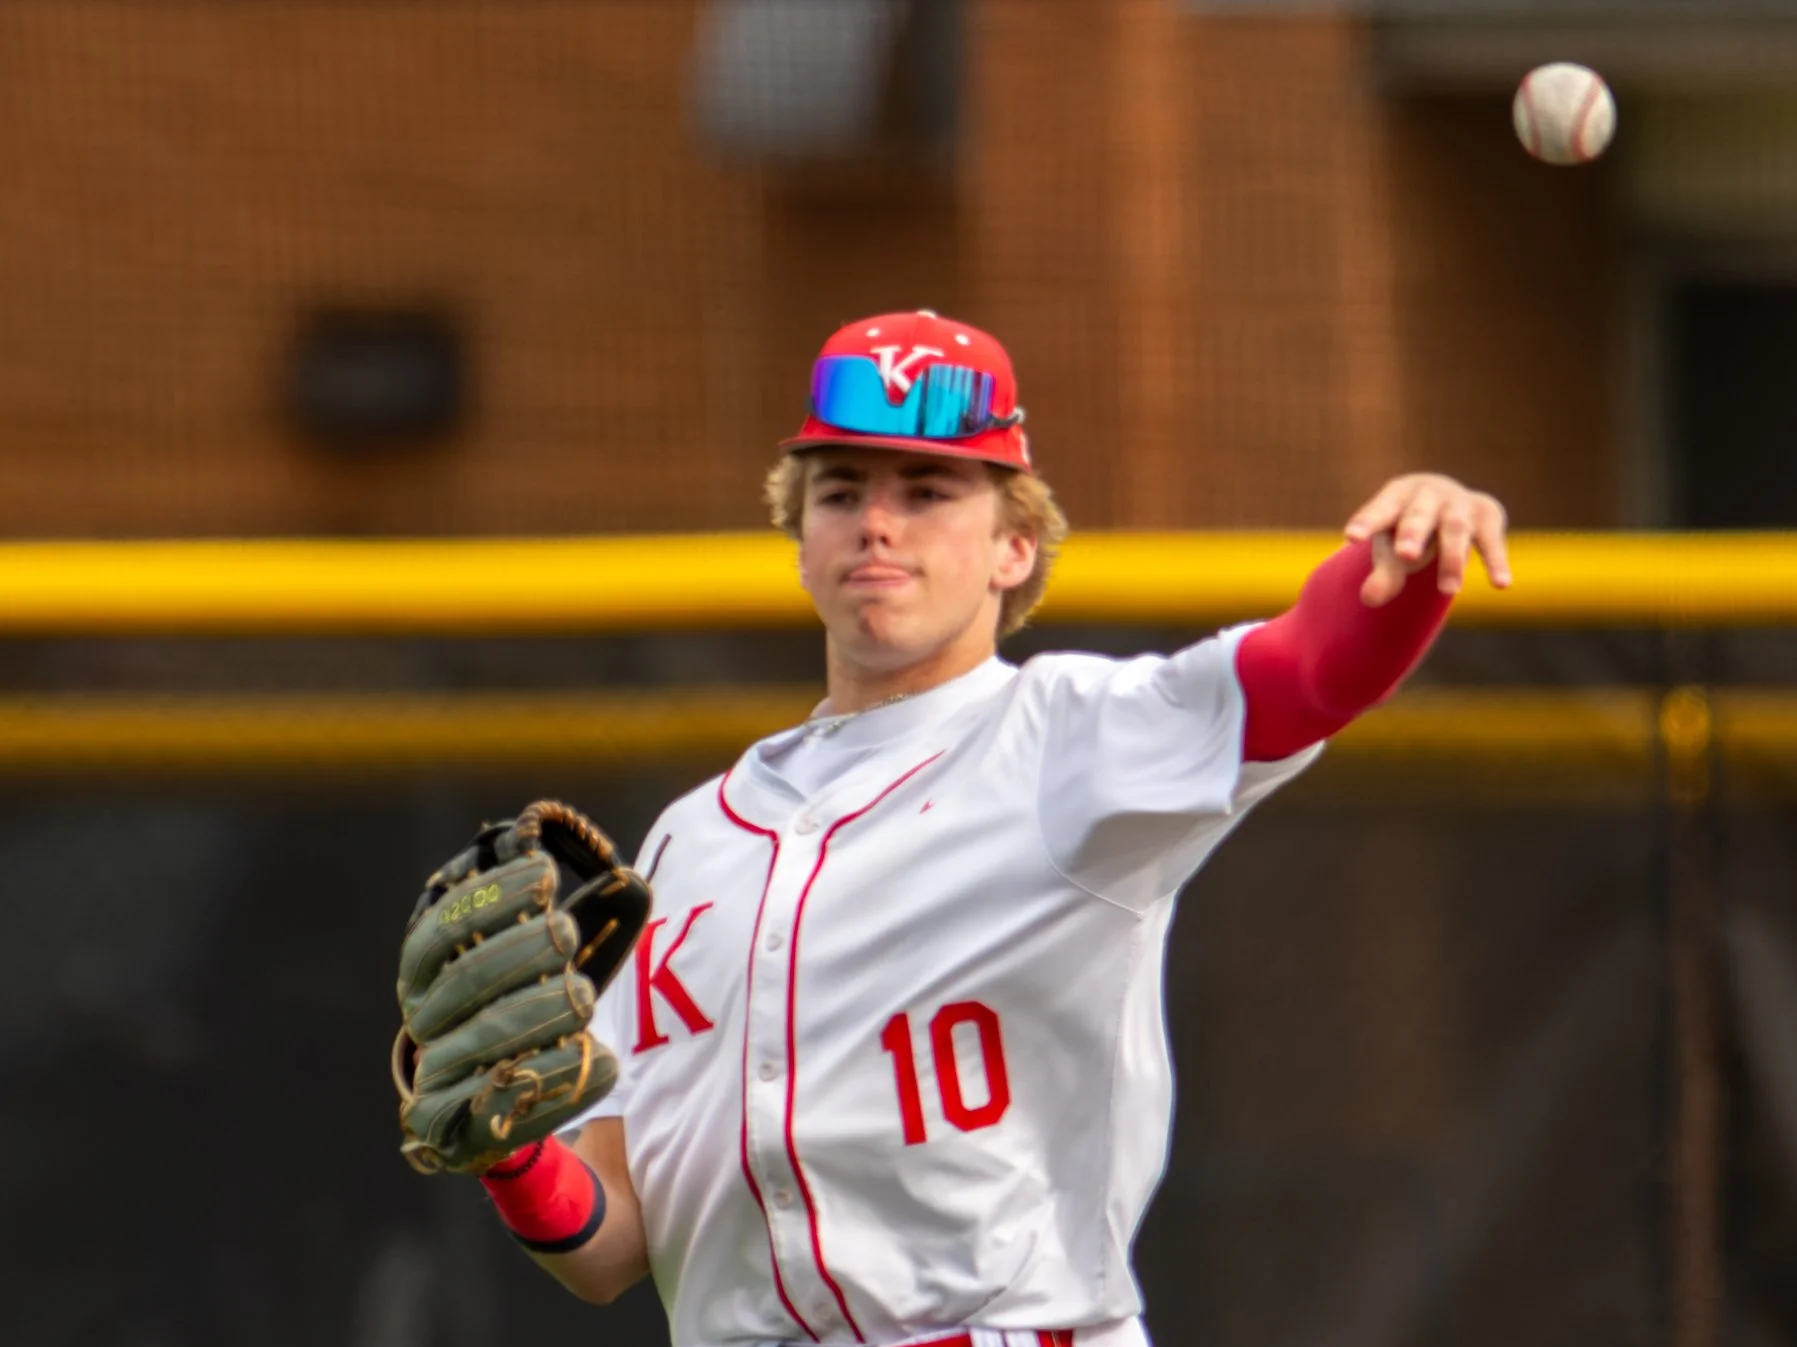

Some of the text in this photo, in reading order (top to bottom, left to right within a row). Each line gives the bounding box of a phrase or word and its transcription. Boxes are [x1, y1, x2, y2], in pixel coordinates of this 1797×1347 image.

[870, 345, 944, 393] K
[632, 901, 714, 1055] K
[881, 1001, 1011, 1146] 10
